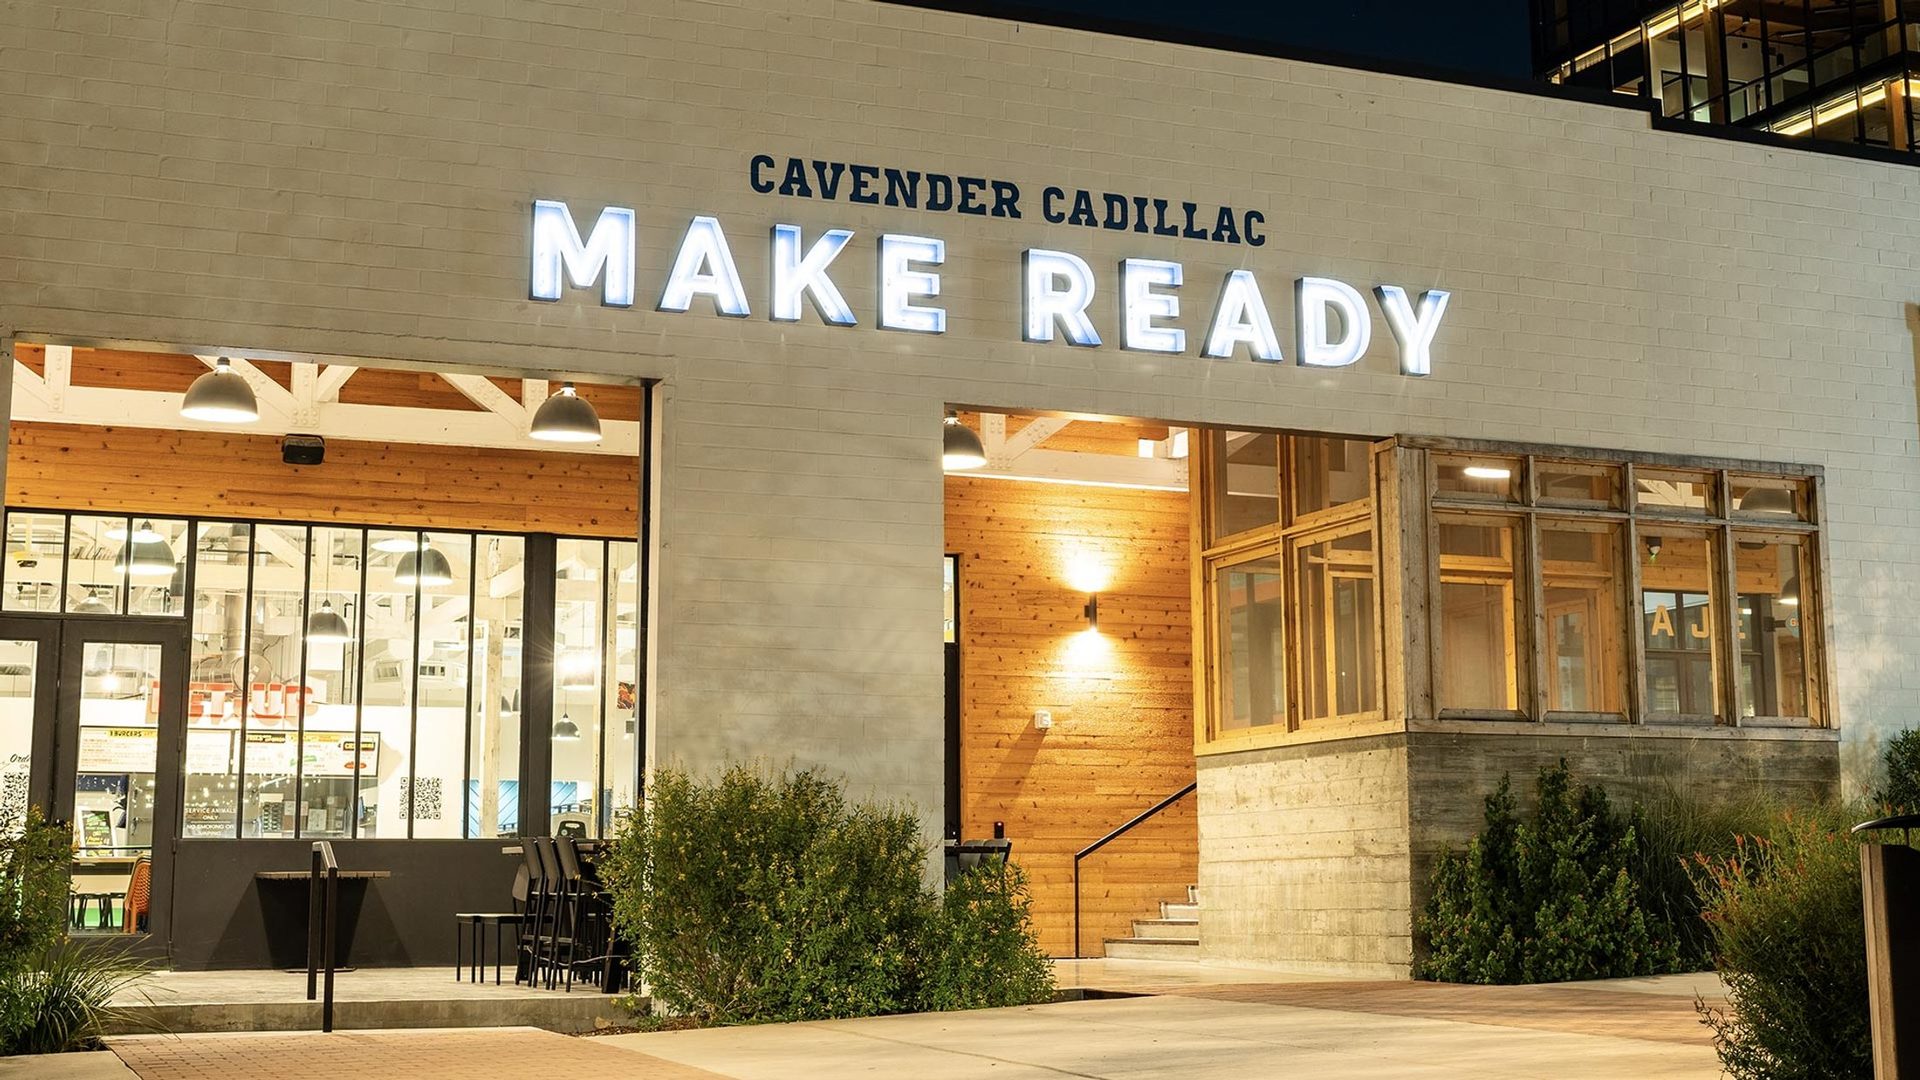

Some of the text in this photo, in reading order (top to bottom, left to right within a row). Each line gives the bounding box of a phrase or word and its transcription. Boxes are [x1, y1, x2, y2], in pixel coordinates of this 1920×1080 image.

[750, 154, 1266, 247] CAVENDER CADILLAC
[528, 199, 1451, 377] MAKE READY
